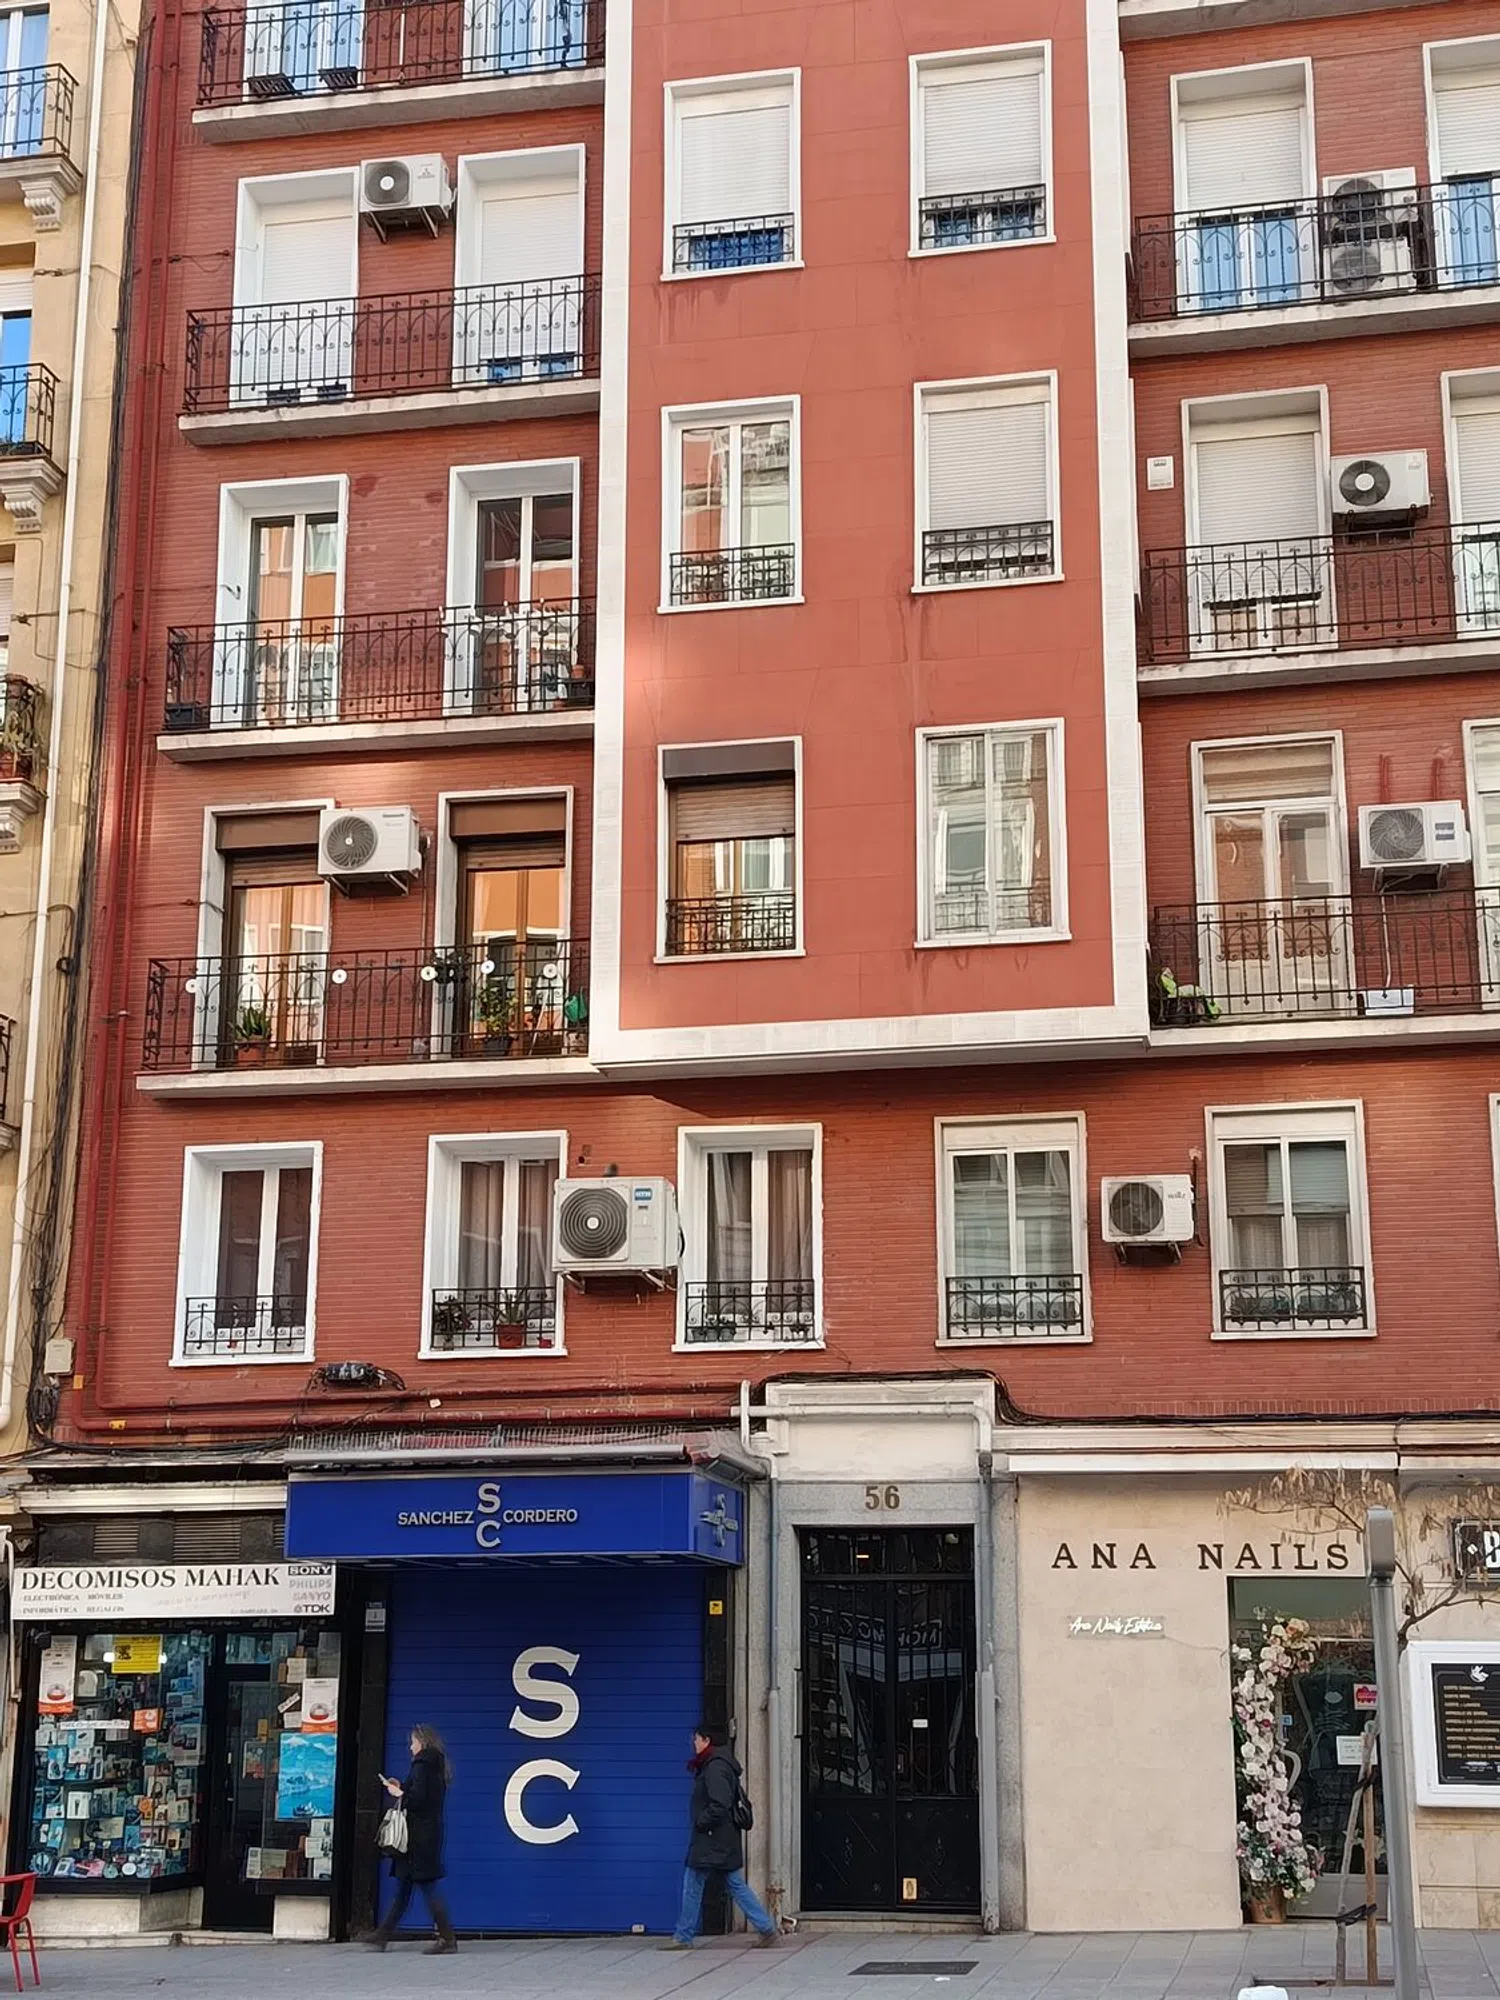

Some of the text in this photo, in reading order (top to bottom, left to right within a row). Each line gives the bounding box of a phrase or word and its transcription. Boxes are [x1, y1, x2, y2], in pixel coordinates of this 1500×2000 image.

[477, 1482, 501, 1514] S
[864, 1485, 900, 1510] 56
[398, 1509, 578, 1526] SANCHEZ CORDERO
[476, 1519, 502, 1548] C
[1051, 1542, 1349, 1570] ANA NAILS
[21, 1567, 280, 1591] DECOMISOS MAHAK
[288, 1566, 332, 1576] SONY
[289, 1579, 332, 1589] PHILIPS
[292, 1591, 331, 1601] SANYO
[304, 1604, 331, 1613] TDK
[1069, 1616, 1092, 1635] Ana
[508, 1646, 580, 1739] S
[504, 1758, 581, 1844] C
